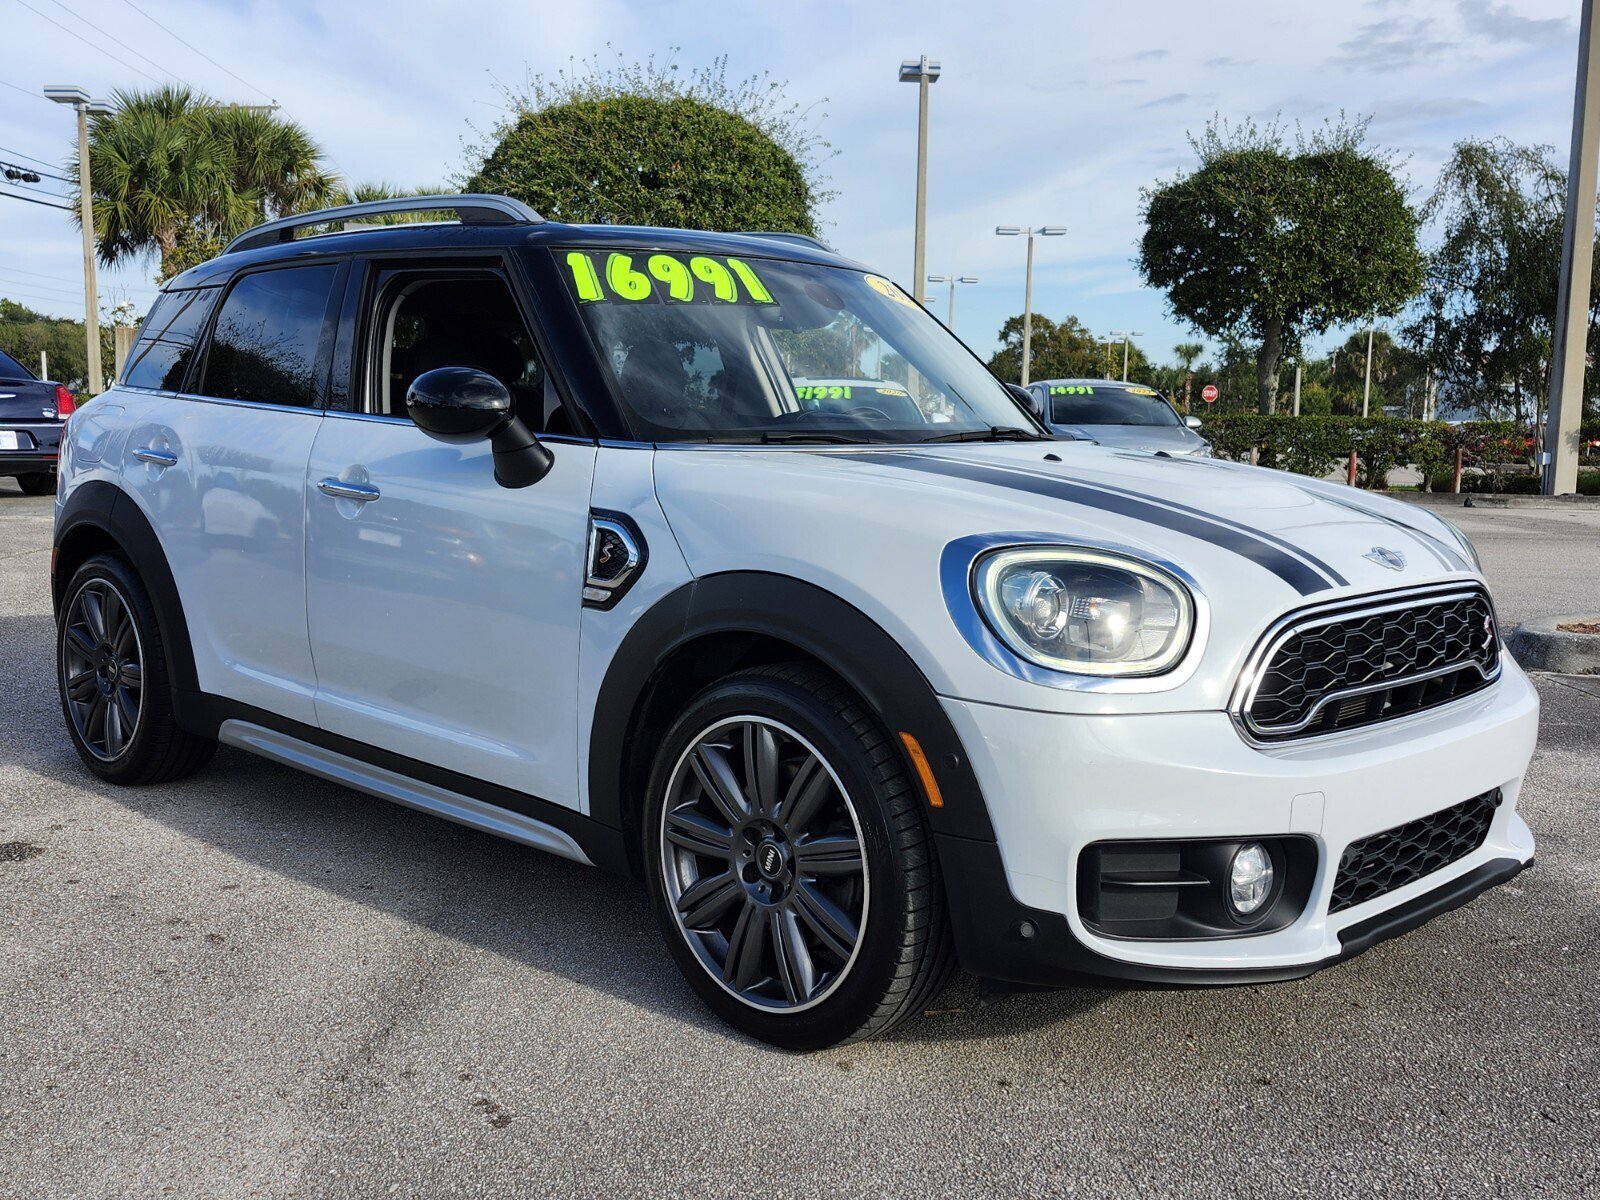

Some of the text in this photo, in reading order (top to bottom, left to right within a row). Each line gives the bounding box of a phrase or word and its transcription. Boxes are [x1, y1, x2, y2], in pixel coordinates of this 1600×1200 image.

[566, 252, 774, 303] 16991
[1203, 389, 1217, 398] STOP
[764, 848, 776, 872] MINI
